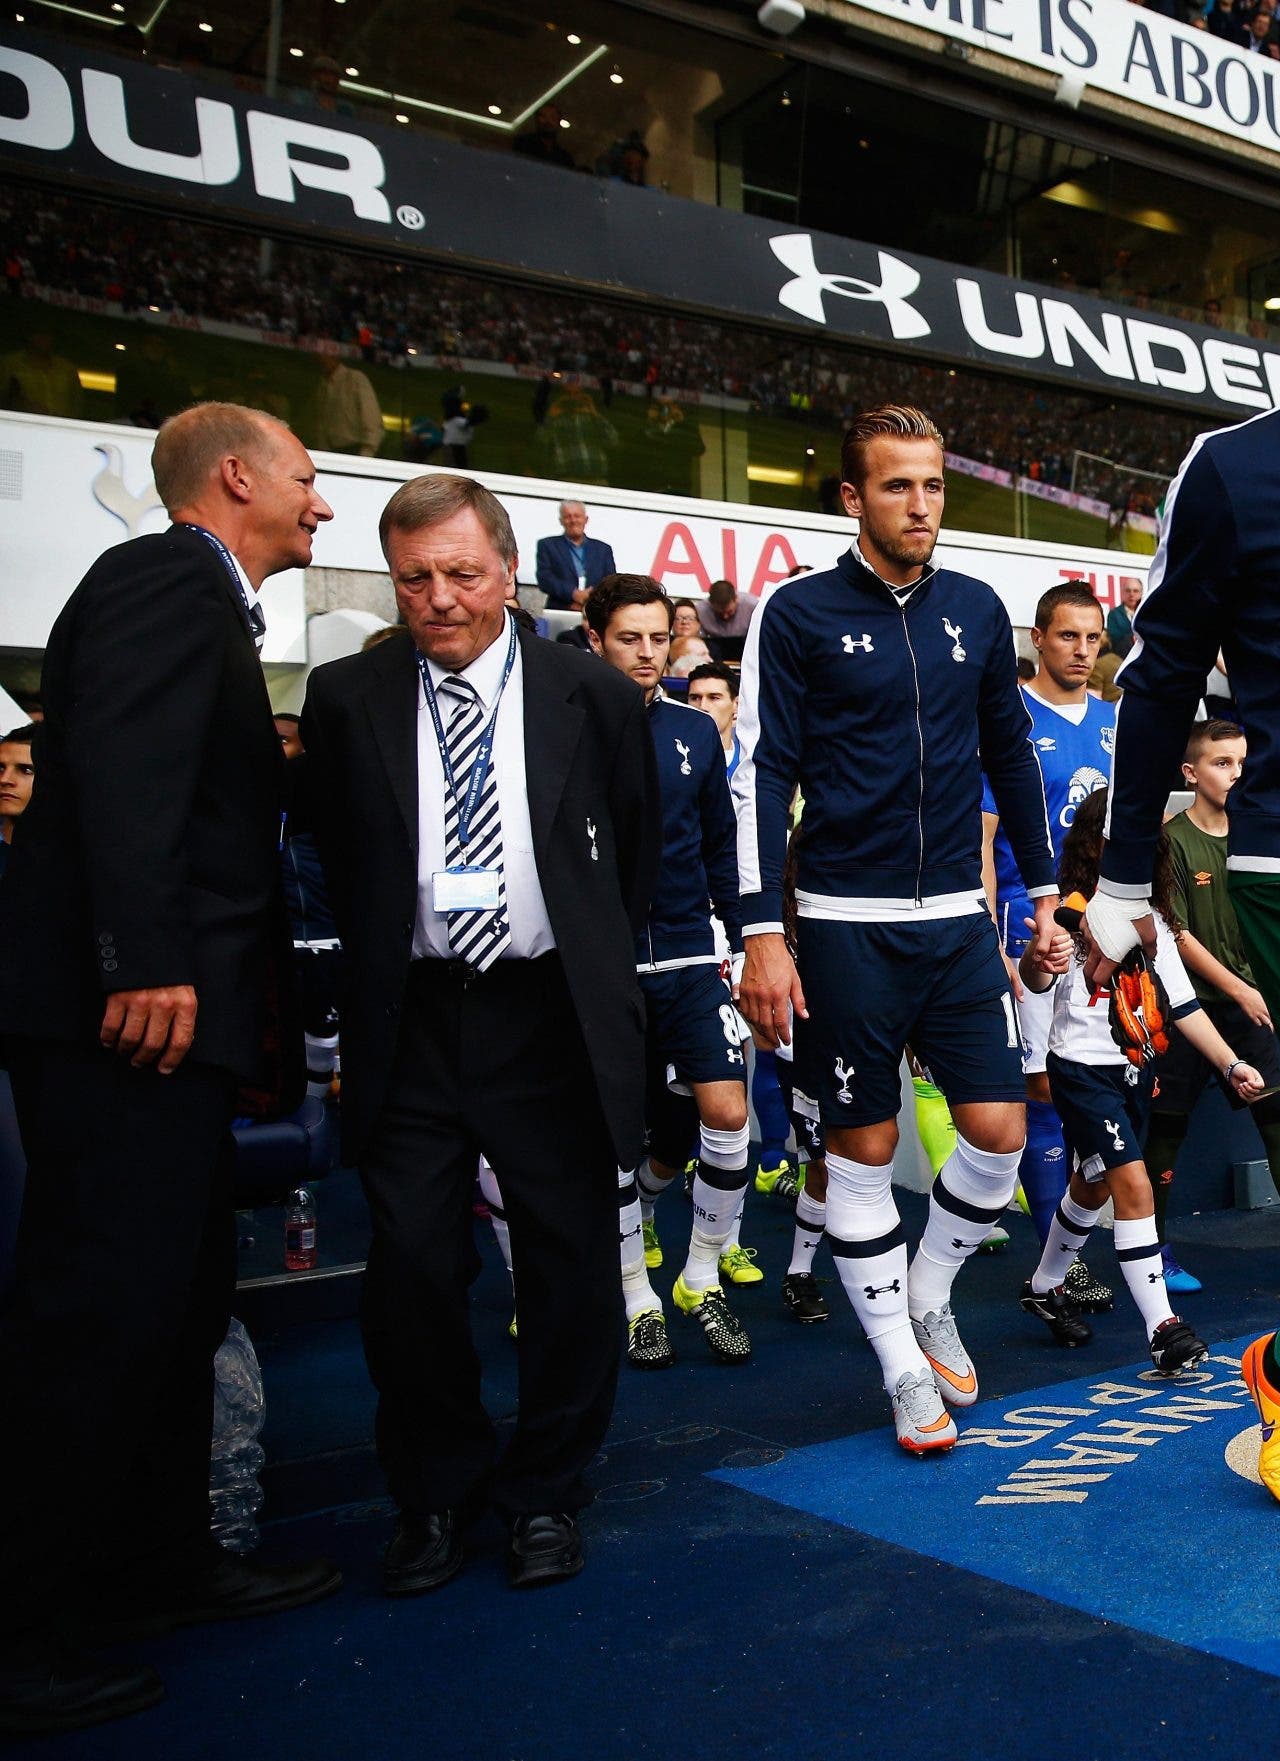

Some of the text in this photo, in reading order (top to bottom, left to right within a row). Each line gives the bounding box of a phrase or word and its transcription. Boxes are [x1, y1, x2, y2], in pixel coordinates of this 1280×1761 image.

[1039, 0, 1098, 69] IS
[649, 521, 801, 598] AIA
[718, 1004, 742, 1047] 8
